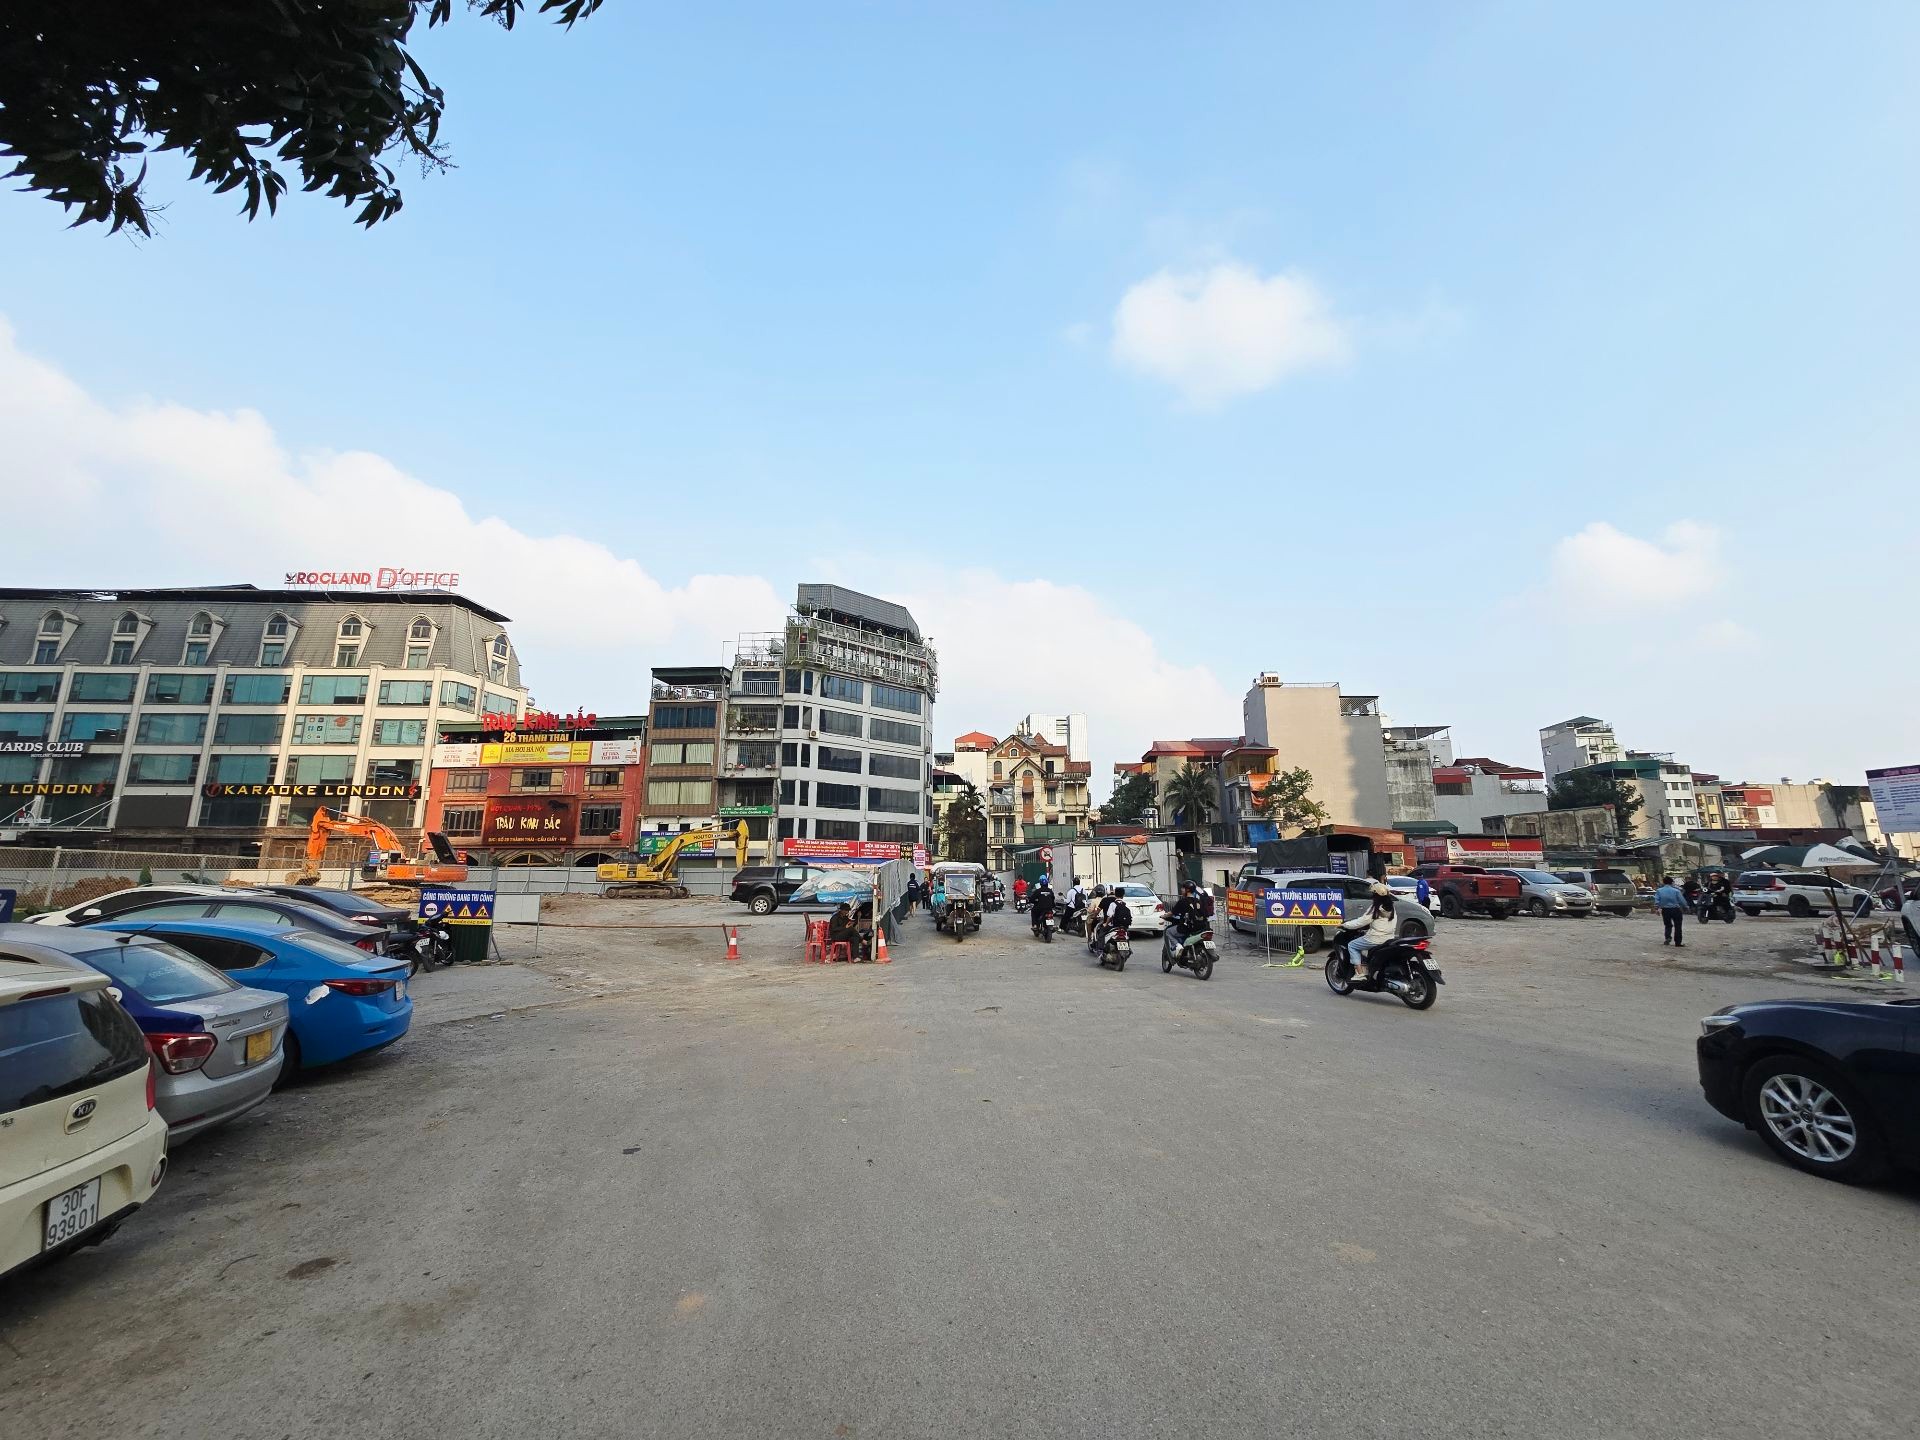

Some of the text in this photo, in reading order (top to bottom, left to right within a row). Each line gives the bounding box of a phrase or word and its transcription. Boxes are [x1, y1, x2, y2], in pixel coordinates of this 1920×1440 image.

[296, 572, 371, 585] ROCLAND
[504, 731, 516, 743] 28
[46, 742, 84, 752] CLUB
[10, 784, 93, 794] LONDON
[224, 785, 405, 796] KARAOKE LONDON
[496, 815, 515, 829] TRÂU
[423, 891, 494, 902] CÔNG TRƯỜNG ĐANG THI CÔNG
[1266, 889, 1342, 901] CÔNG TRƯỜNG ĐANG THI CÔNG
[77, 1102, 95, 1116] KIA
[61, 1184, 89, 1217] 30F
[47, 1203, 96, 1247] 939.01
